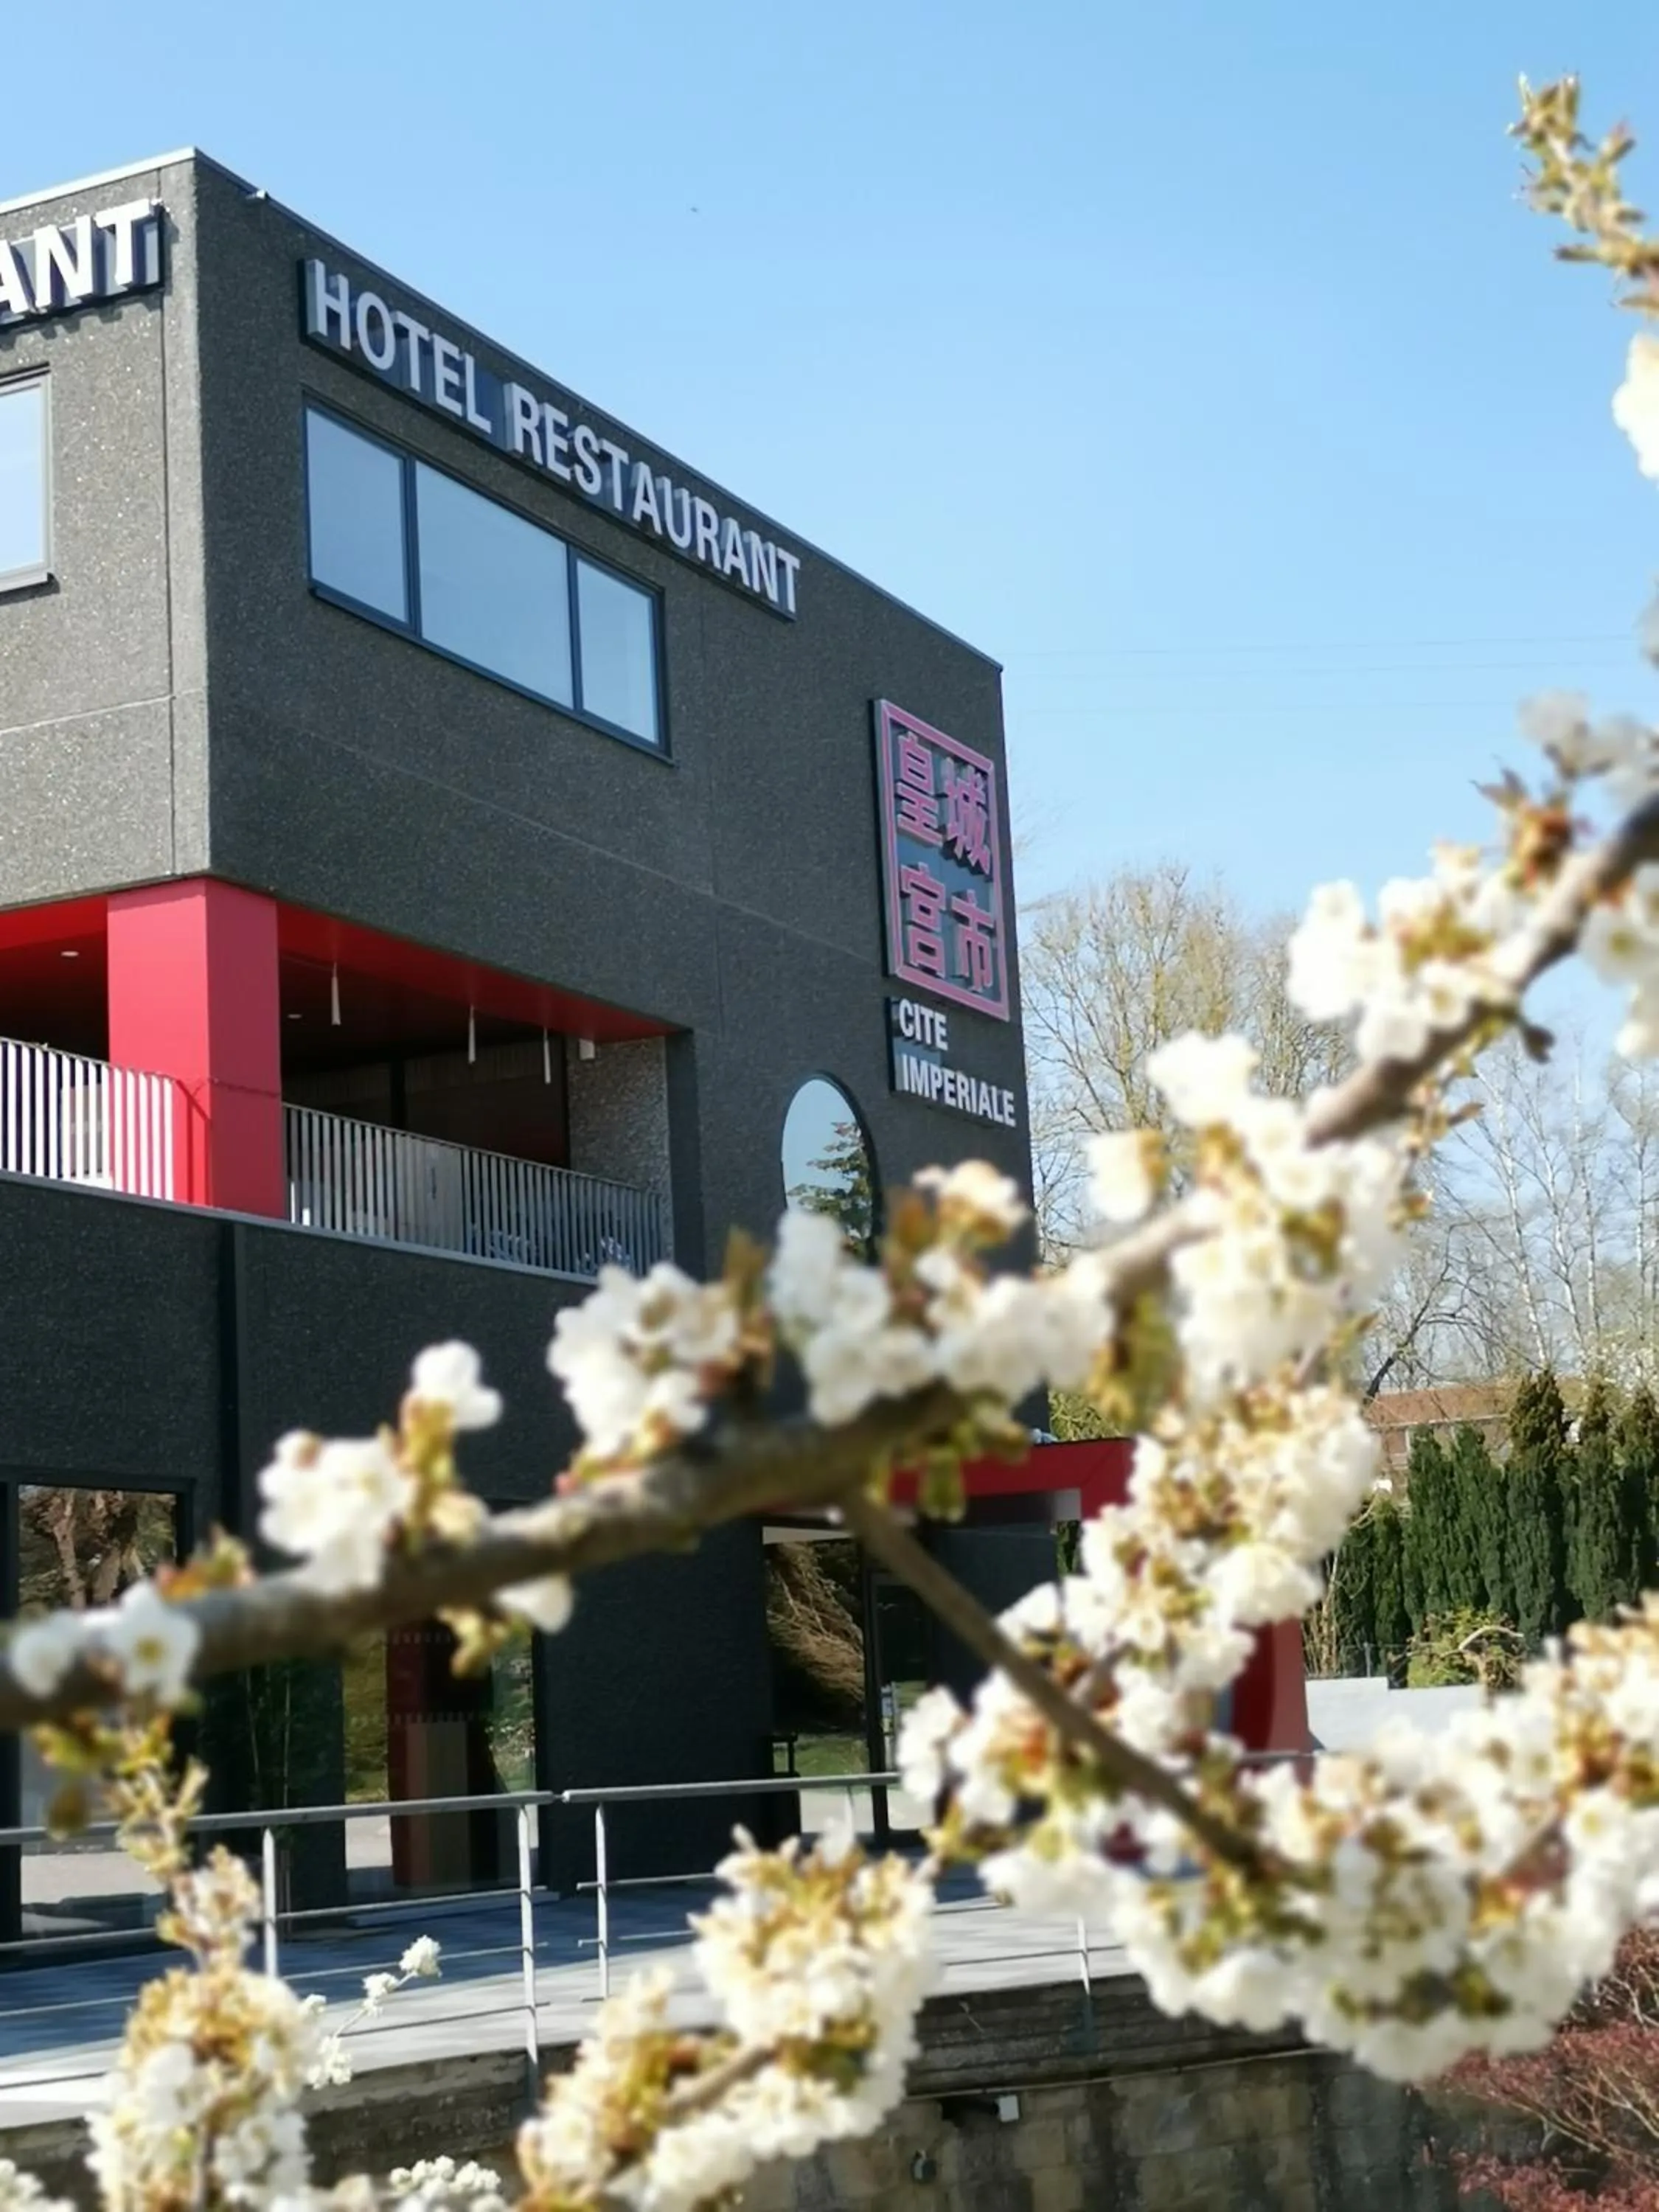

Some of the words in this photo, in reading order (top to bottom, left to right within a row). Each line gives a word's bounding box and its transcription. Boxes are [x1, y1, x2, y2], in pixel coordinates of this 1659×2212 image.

[307, 258, 492, 434] HOTEL
[505, 381, 801, 613] RESTAURANT
[899, 998, 949, 1051] CITE
[901, 1053, 1017, 1127] IMPERIALE
